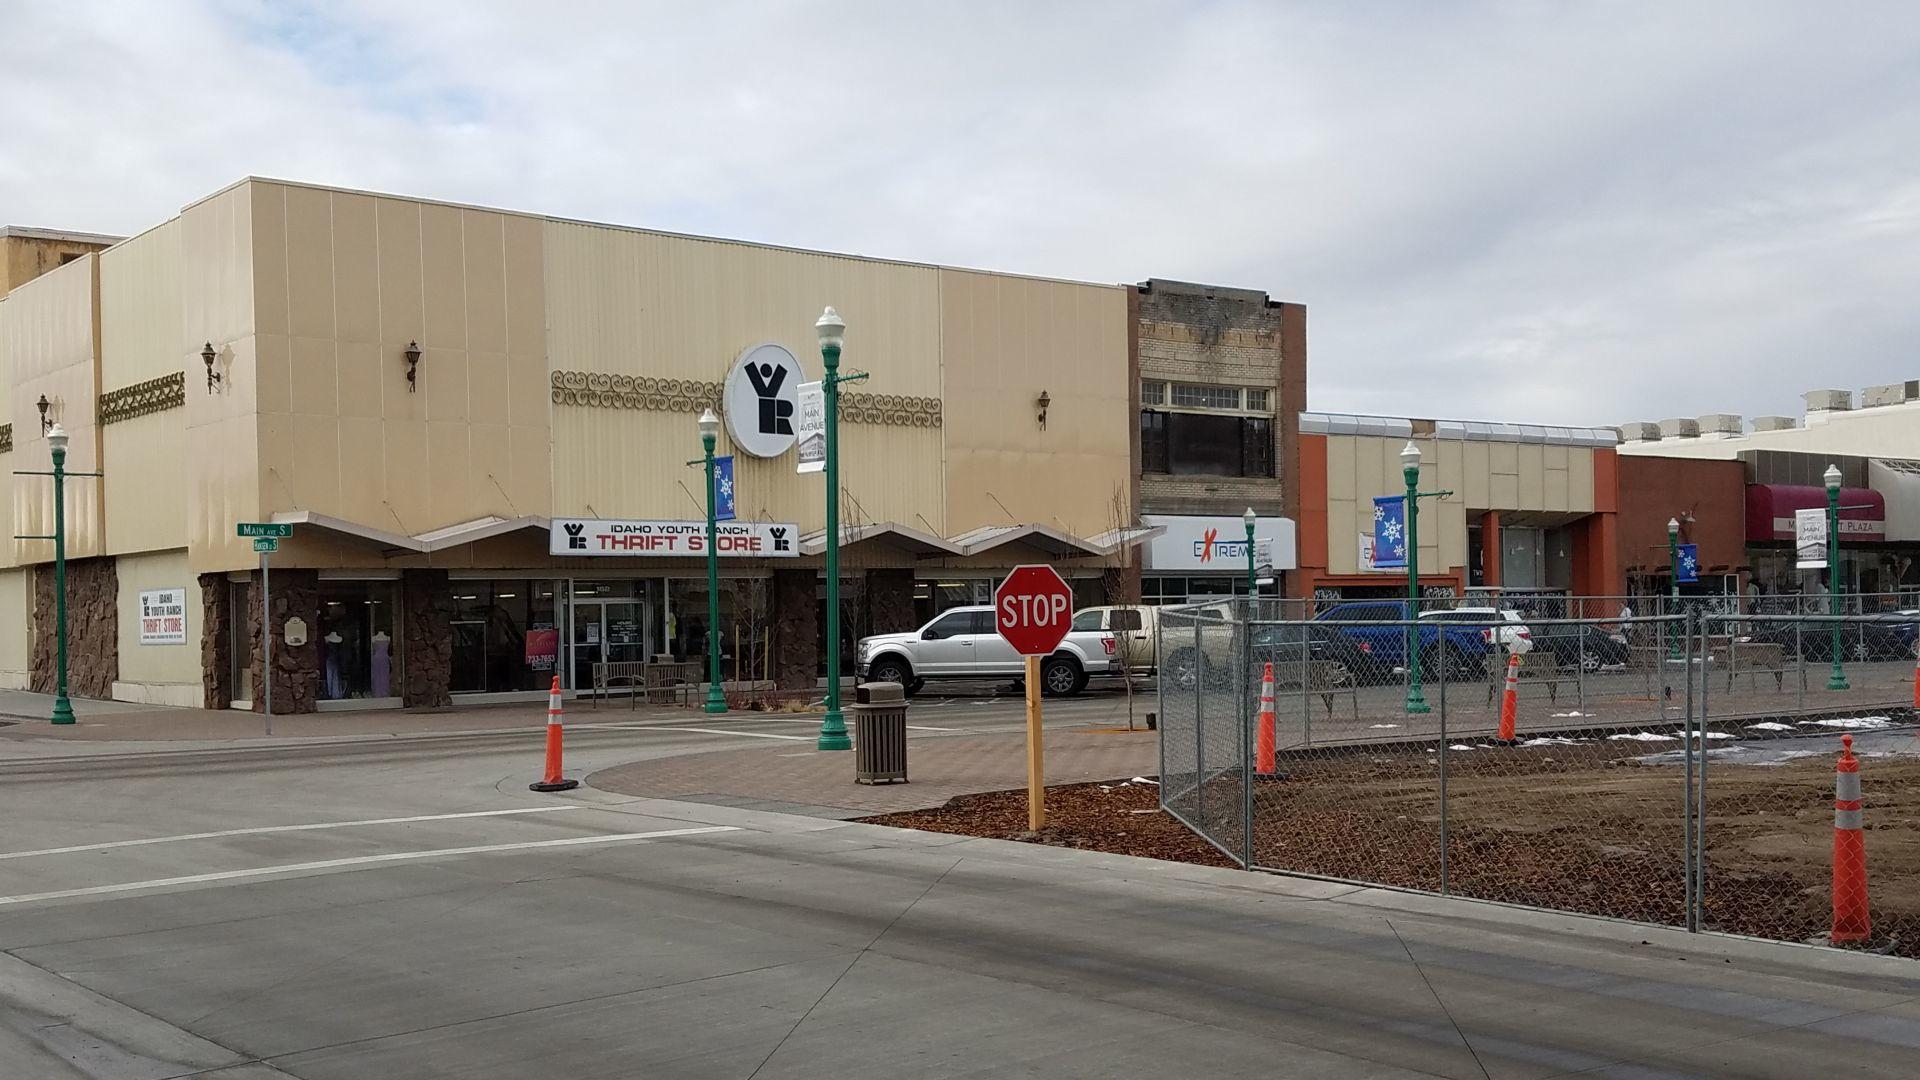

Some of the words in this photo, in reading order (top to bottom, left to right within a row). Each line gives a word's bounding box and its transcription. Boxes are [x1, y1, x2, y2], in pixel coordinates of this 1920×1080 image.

[804, 409, 820, 419] MAIN
[800, 421, 824, 432] AVENUE
[279, 525, 286, 536] S
[611, 525, 652, 534] IDAHO
[657, 525, 700, 534] YOUTH
[1848, 522, 1873, 531] PLAZA
[596, 534, 678, 551] THRIFT
[688, 535, 762, 552] SORE
[1797, 534, 1826, 542] AVENUE
[1002, 594, 1067, 628] STOP
[143, 618, 161, 633] THRIFT
[163, 617, 182, 632] STORE
